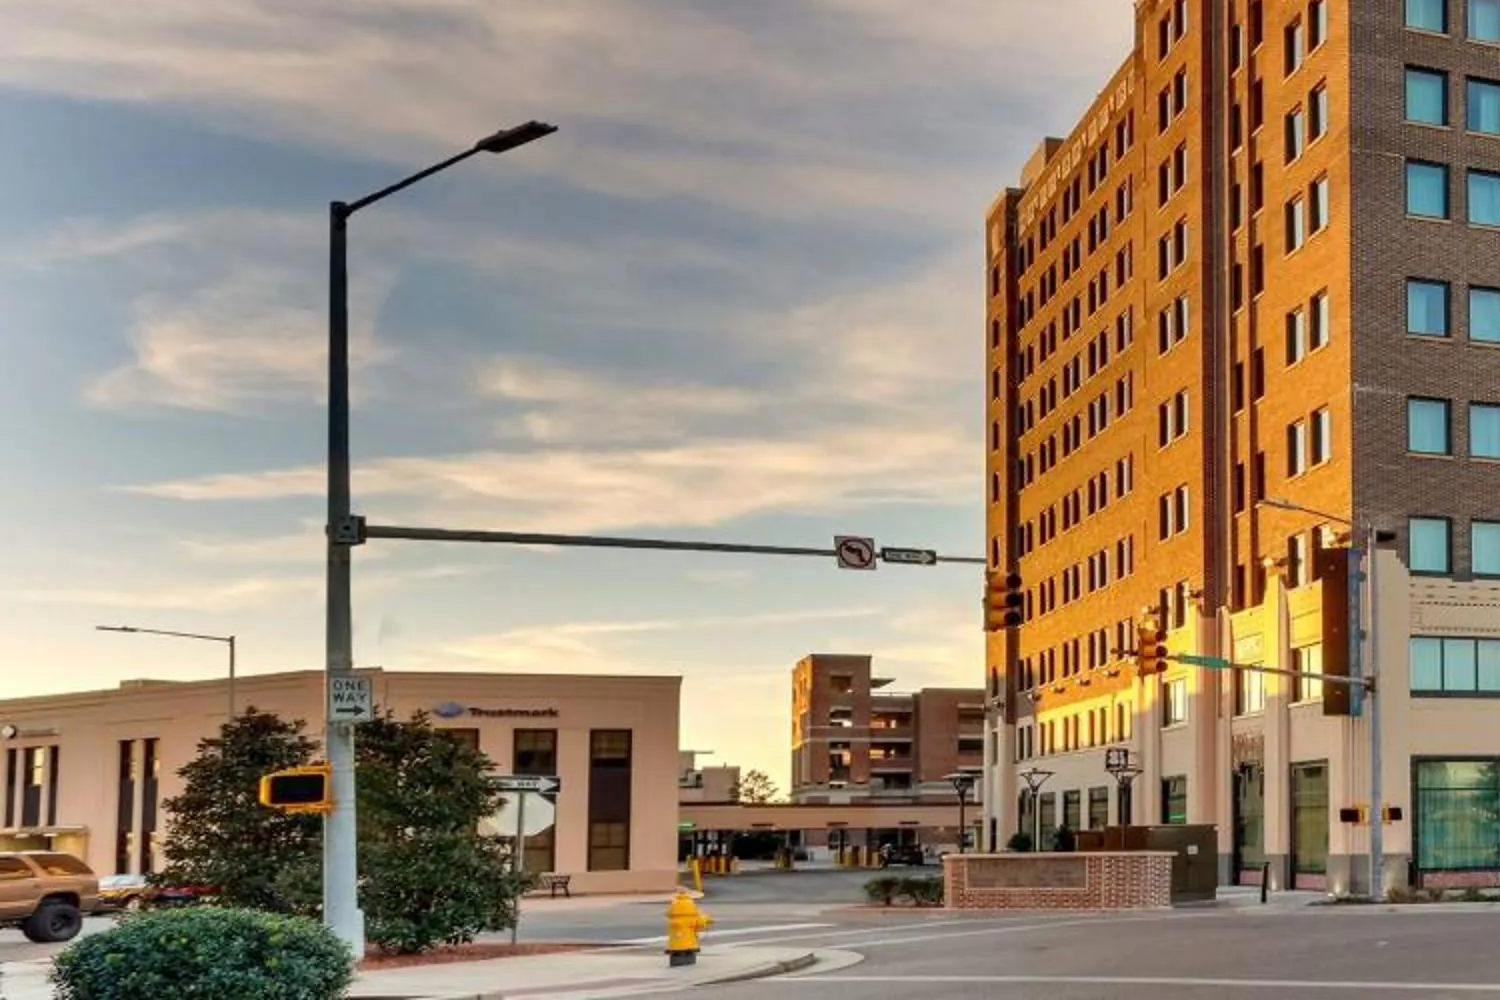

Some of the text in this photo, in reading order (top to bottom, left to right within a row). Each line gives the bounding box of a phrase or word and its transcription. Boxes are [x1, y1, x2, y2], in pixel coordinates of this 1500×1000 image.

[333, 679, 367, 691] ONE
[333, 692, 368, 703] WAY
[467, 707, 559, 717] Trustmark
